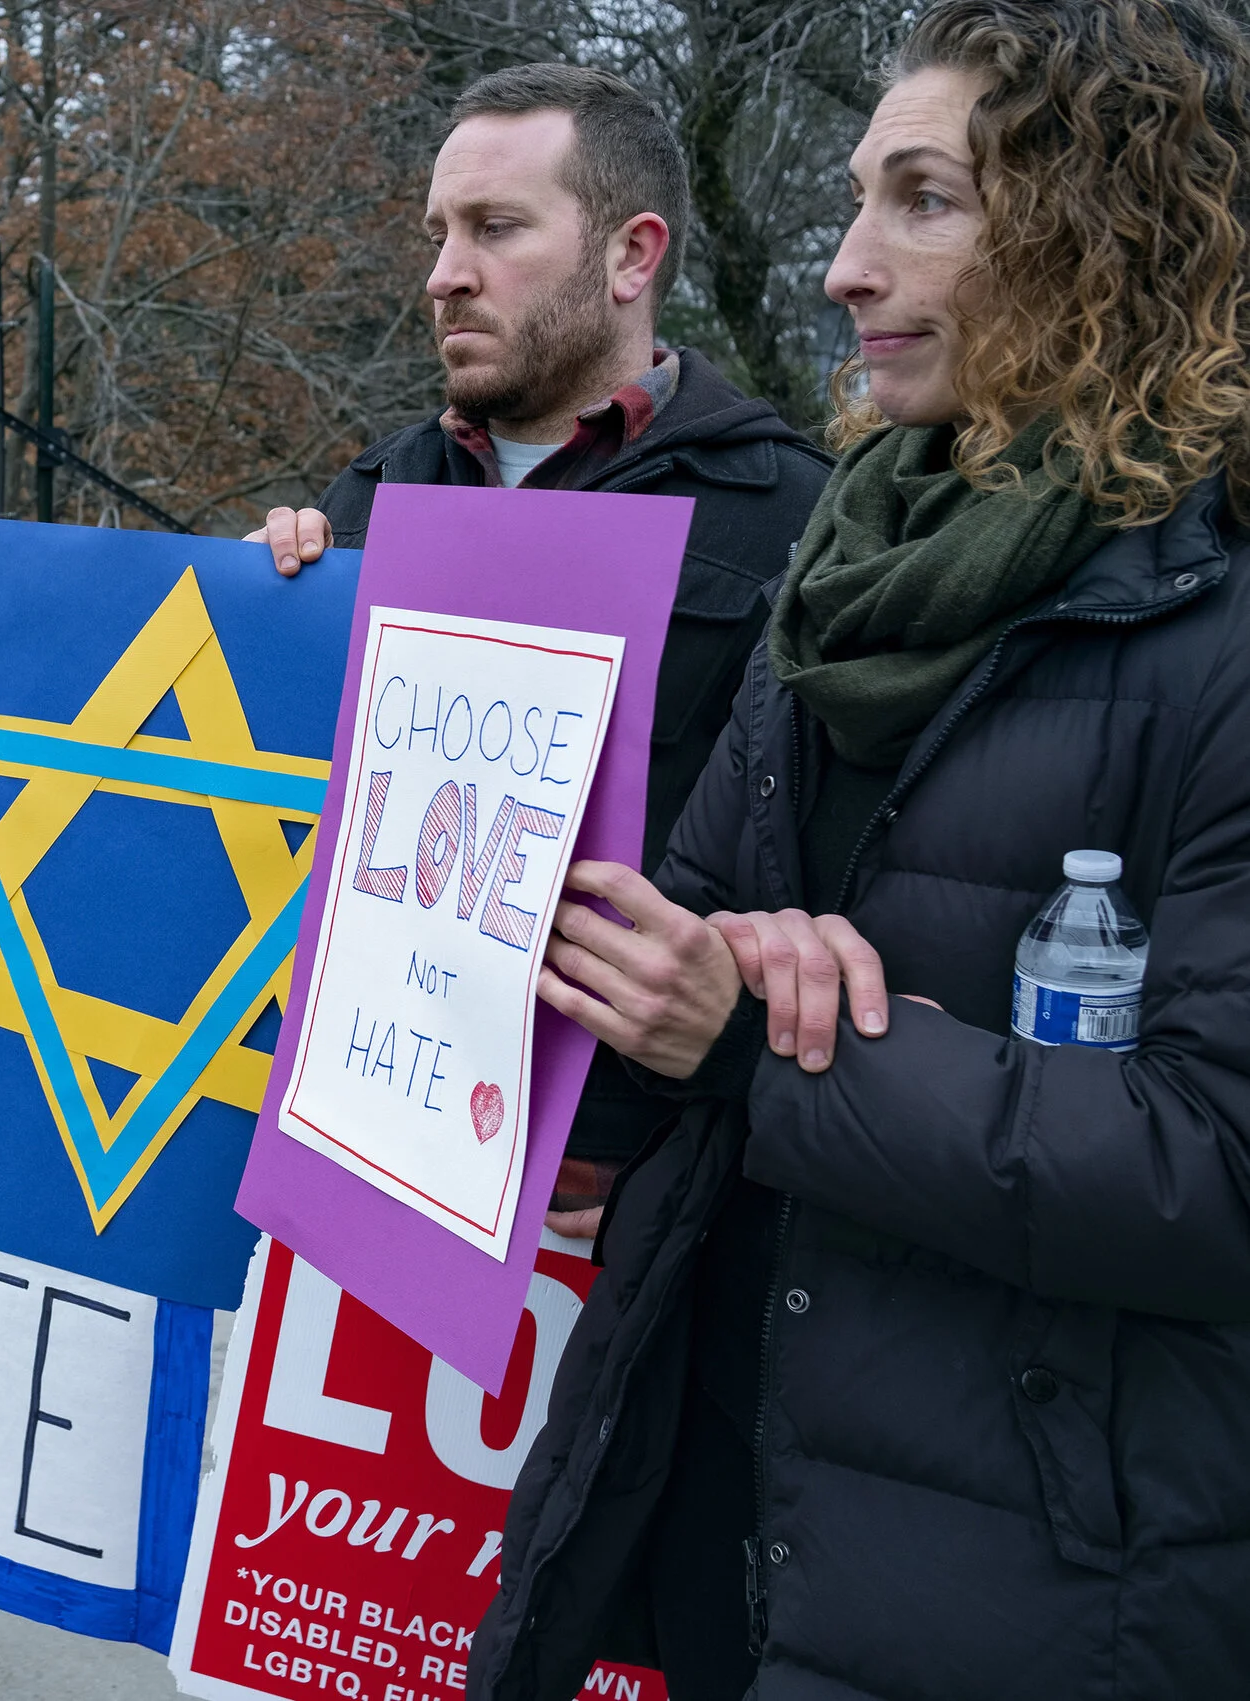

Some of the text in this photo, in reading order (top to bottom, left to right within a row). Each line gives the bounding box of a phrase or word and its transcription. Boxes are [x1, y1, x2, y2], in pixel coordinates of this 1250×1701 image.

[374, 676, 583, 784] CHOOSE
[353, 770, 566, 952] LOVE
[407, 951, 458, 999] NOT
[345, 1007, 452, 1112] HATE
[234, 1472, 456, 1561] your
[224, 1599, 406, 1677] DISABLED,
